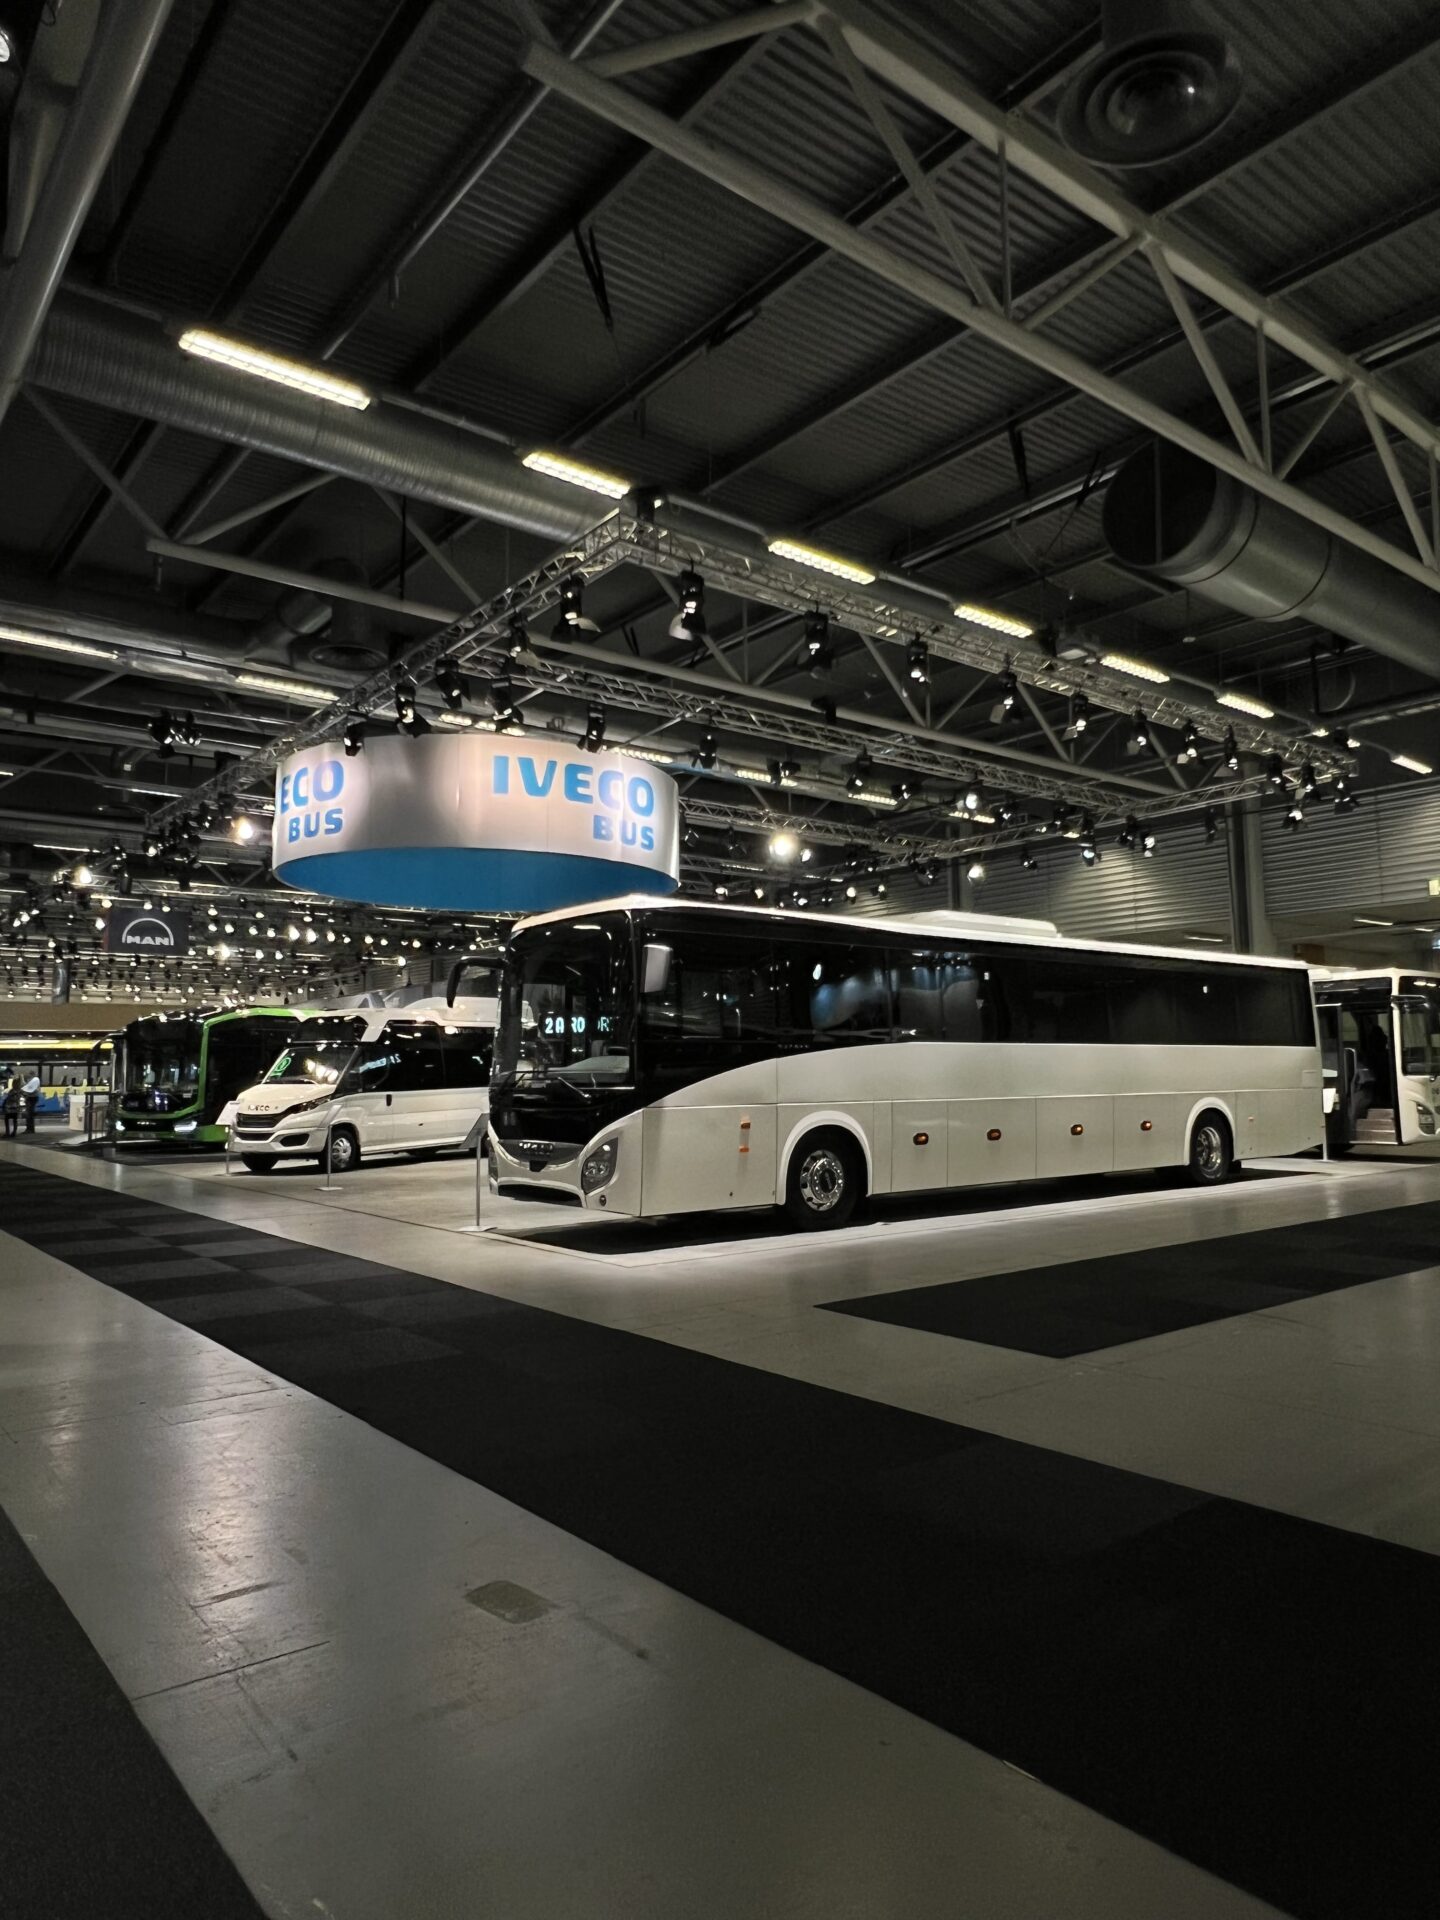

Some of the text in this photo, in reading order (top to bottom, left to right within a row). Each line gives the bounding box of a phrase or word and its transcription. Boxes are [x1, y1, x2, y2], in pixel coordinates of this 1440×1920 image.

[493, 754, 655, 817] IVECO
[288, 807, 344, 843] BUS
[592, 814, 655, 852] BUS
[126, 935, 170, 946] MAN
